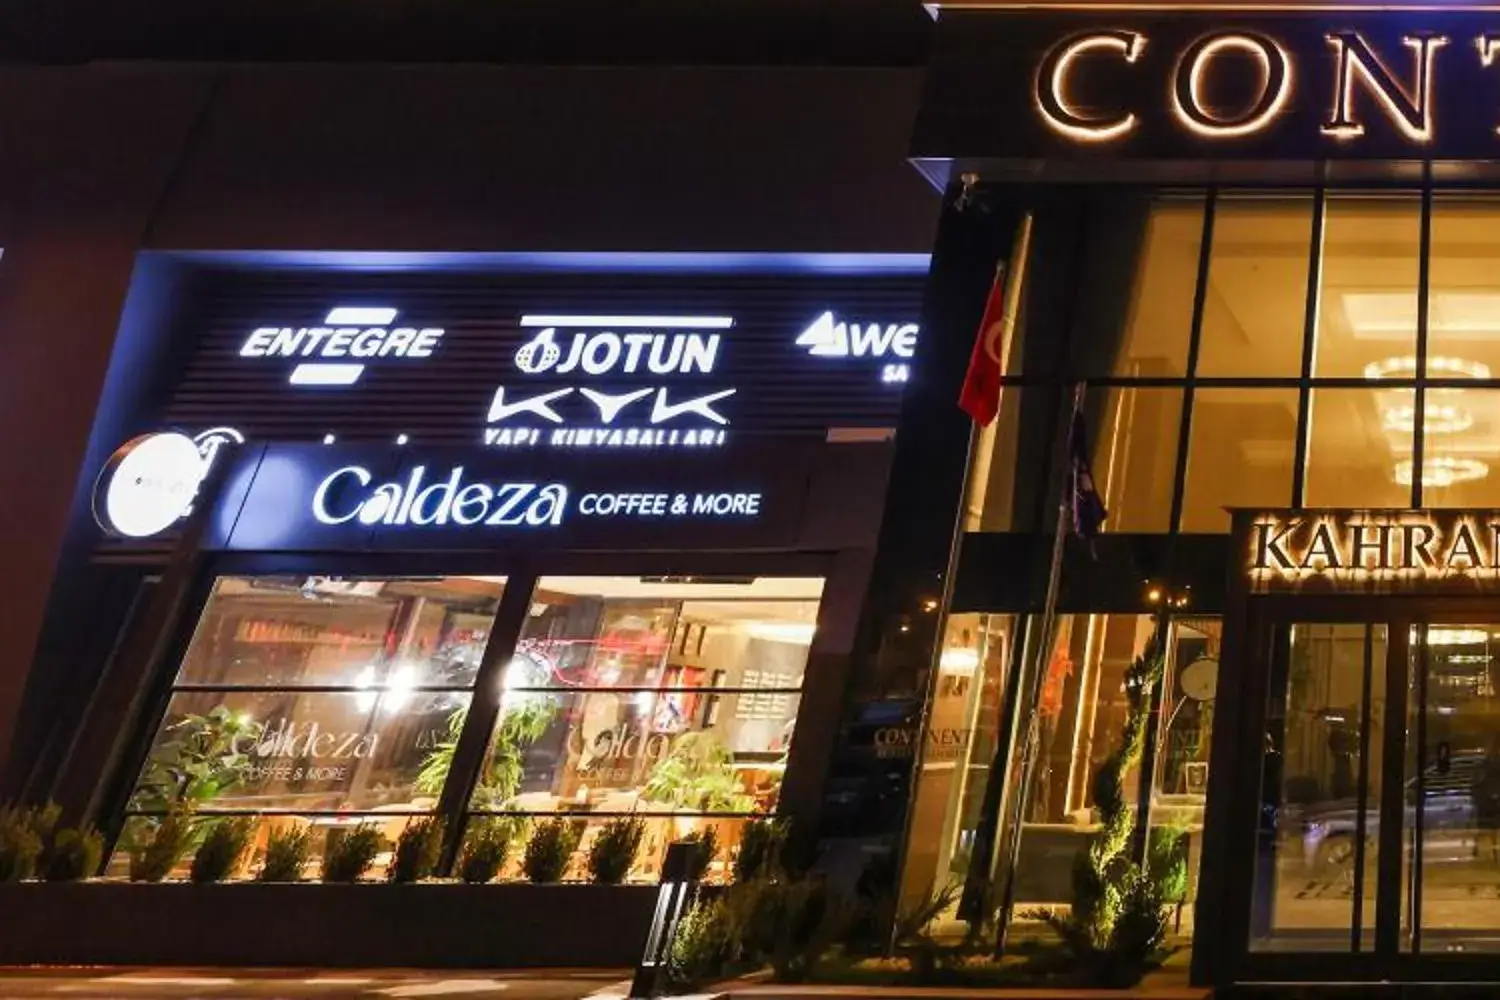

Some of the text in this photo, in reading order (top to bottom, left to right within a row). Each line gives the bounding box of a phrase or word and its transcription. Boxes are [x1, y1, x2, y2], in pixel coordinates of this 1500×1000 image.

[240, 327, 445, 357] ENTEGRE
[556, 332, 720, 375] JOTUN
[486, 386, 738, 424] KYK
[485, 427, 540, 446] YAPI
[313, 465, 761, 526] Caldeza COFFEE & MORE
